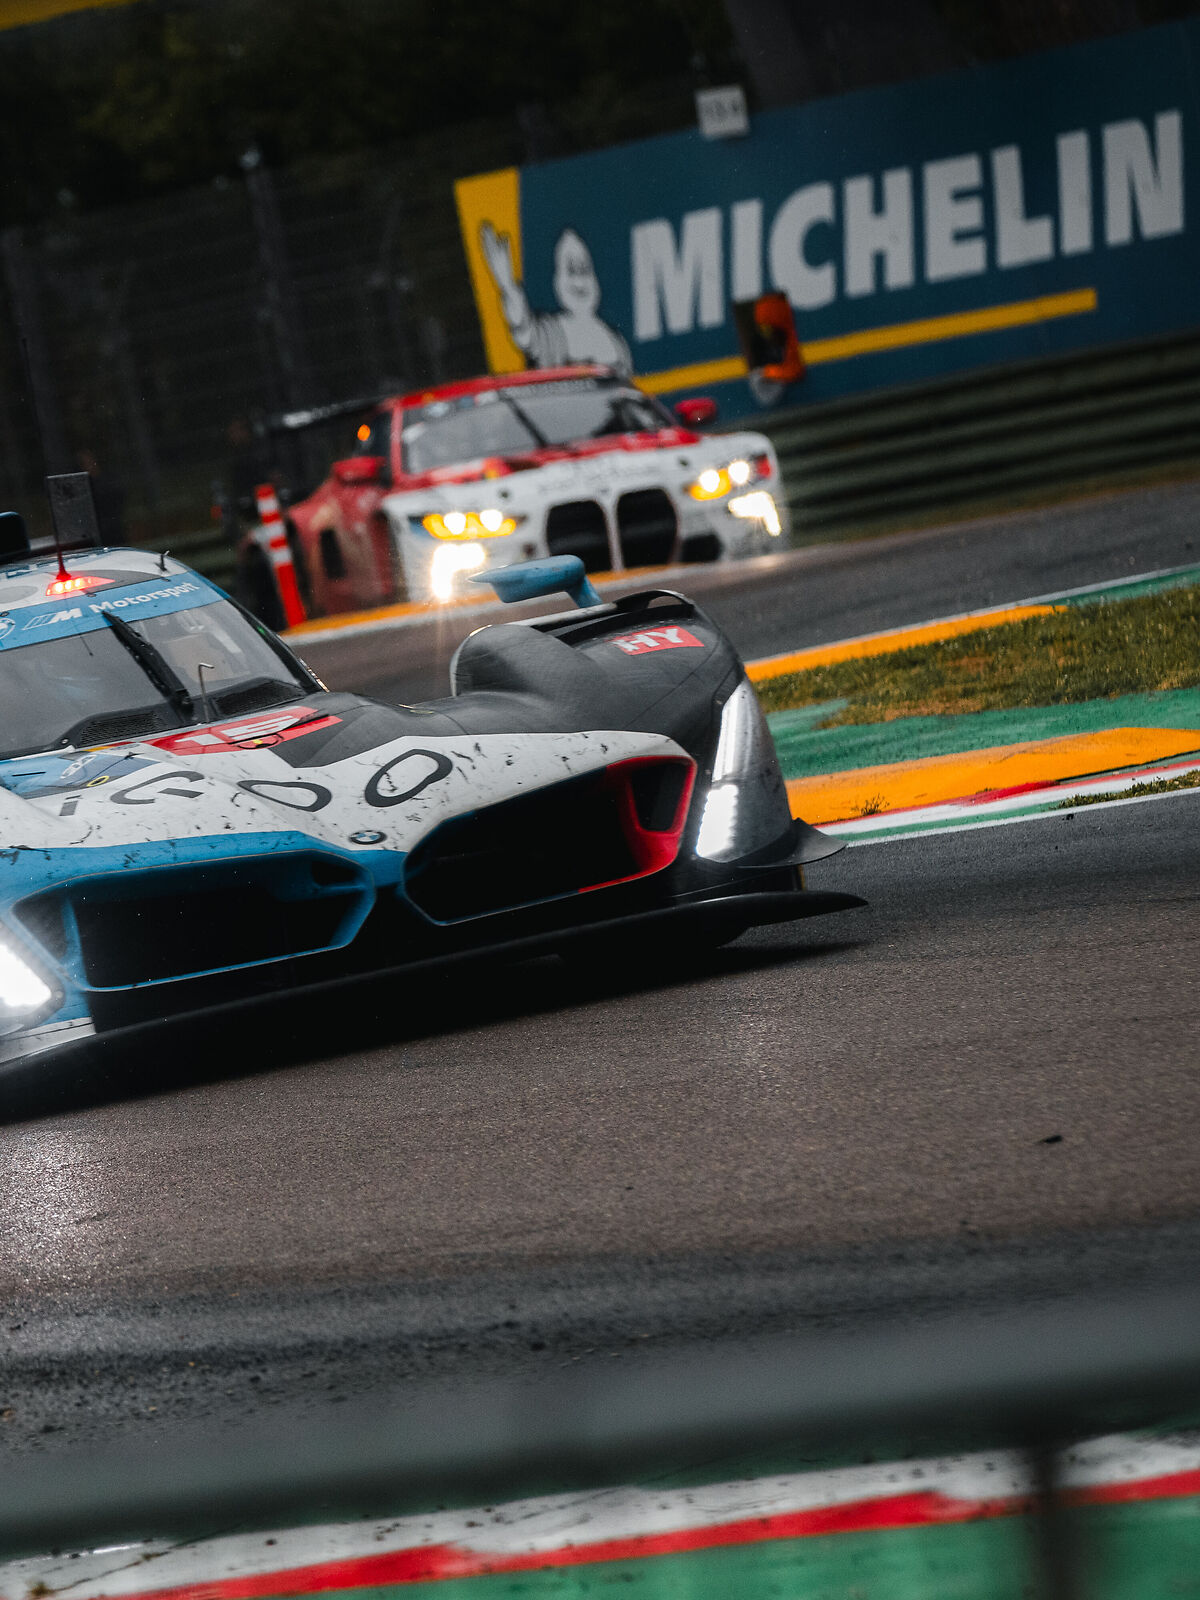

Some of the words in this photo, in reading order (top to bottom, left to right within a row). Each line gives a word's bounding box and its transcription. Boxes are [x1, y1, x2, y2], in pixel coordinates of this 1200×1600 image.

[630, 109, 1185, 343] MICHELIN
[89, 582, 200, 614] Motorsport
[611, 628, 684, 652] HY
[174, 714, 301, 746] 15
